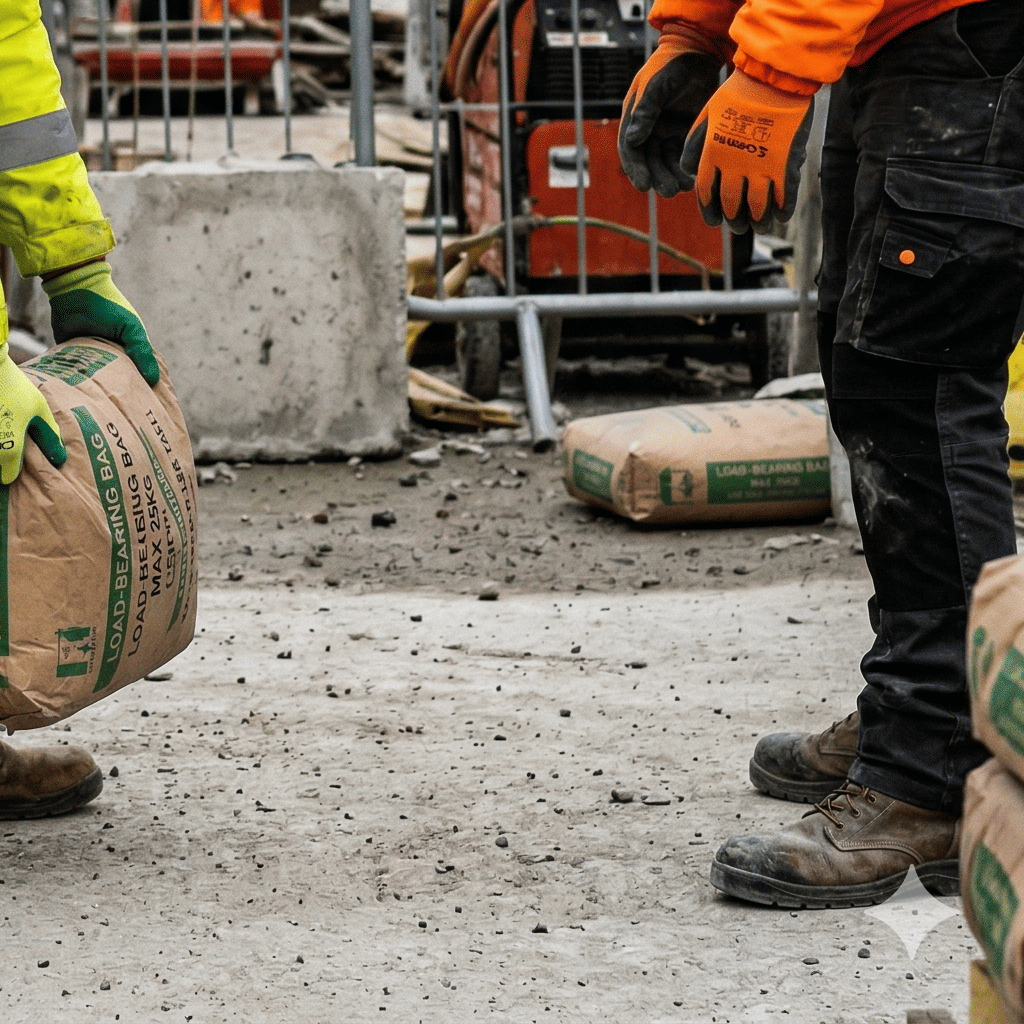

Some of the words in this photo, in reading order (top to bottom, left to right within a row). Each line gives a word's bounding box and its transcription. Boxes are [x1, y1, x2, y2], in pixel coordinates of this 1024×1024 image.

[90, 432, 114, 481] BAG
[106, 422, 133, 468] BAG
[143, 475, 161, 533] 25KG
[106, 487, 129, 663] LOAD-BEARING
[150, 538, 162, 597] MAX
